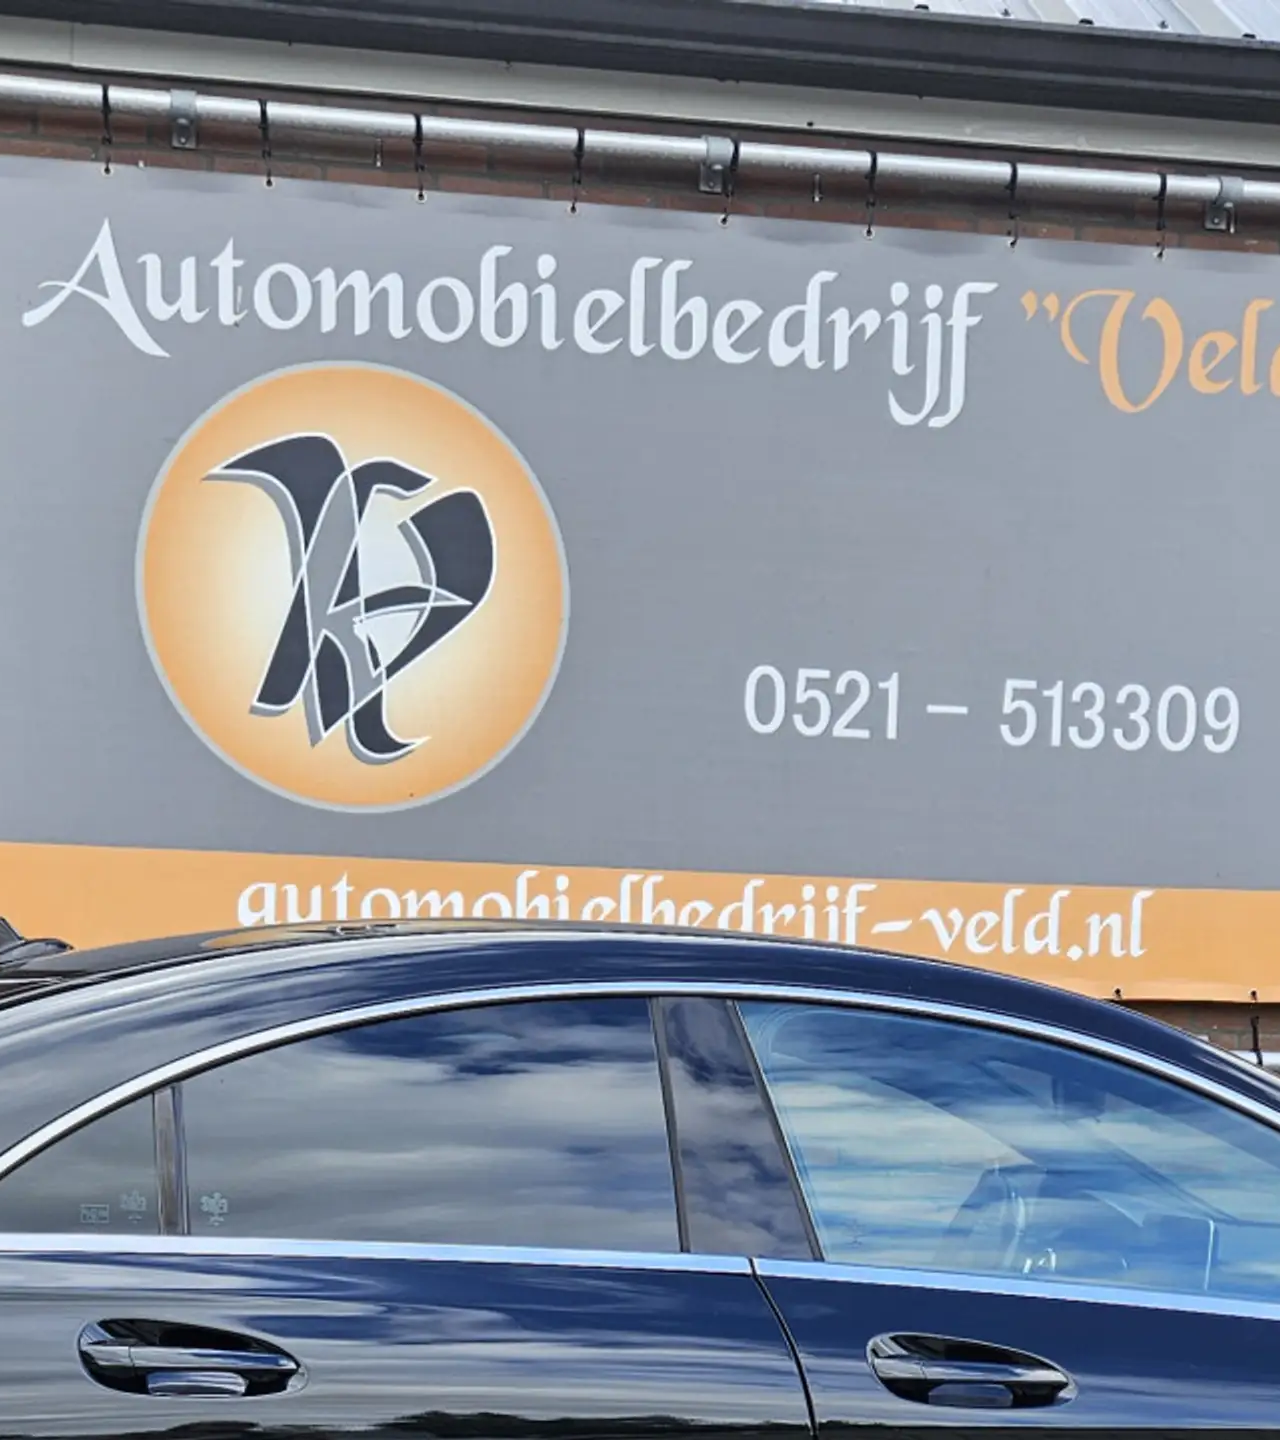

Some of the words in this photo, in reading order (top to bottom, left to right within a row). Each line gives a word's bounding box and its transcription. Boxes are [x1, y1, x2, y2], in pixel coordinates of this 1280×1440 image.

[22, 217, 999, 428] Automobielbedrijf
[744, 665, 900, 739] 0521
[1000, 679, 1240, 753] 513309
